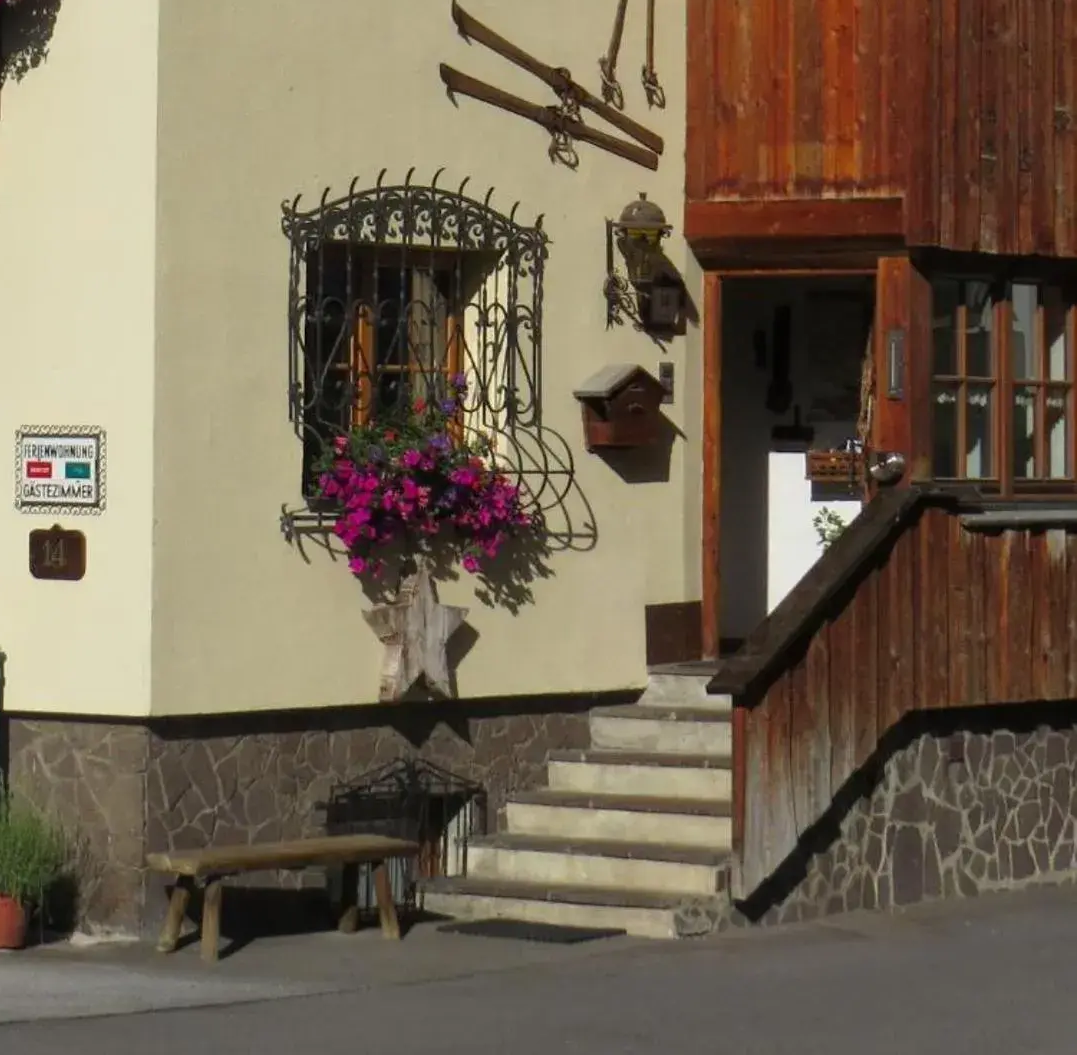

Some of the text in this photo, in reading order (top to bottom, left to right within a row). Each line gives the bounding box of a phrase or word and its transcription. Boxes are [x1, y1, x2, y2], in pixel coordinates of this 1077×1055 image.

[24, 443, 93, 459] FERIENWOHNUNG
[23, 480, 93, 498] GÄSTEZIMMER
[42, 539, 67, 567] 14
